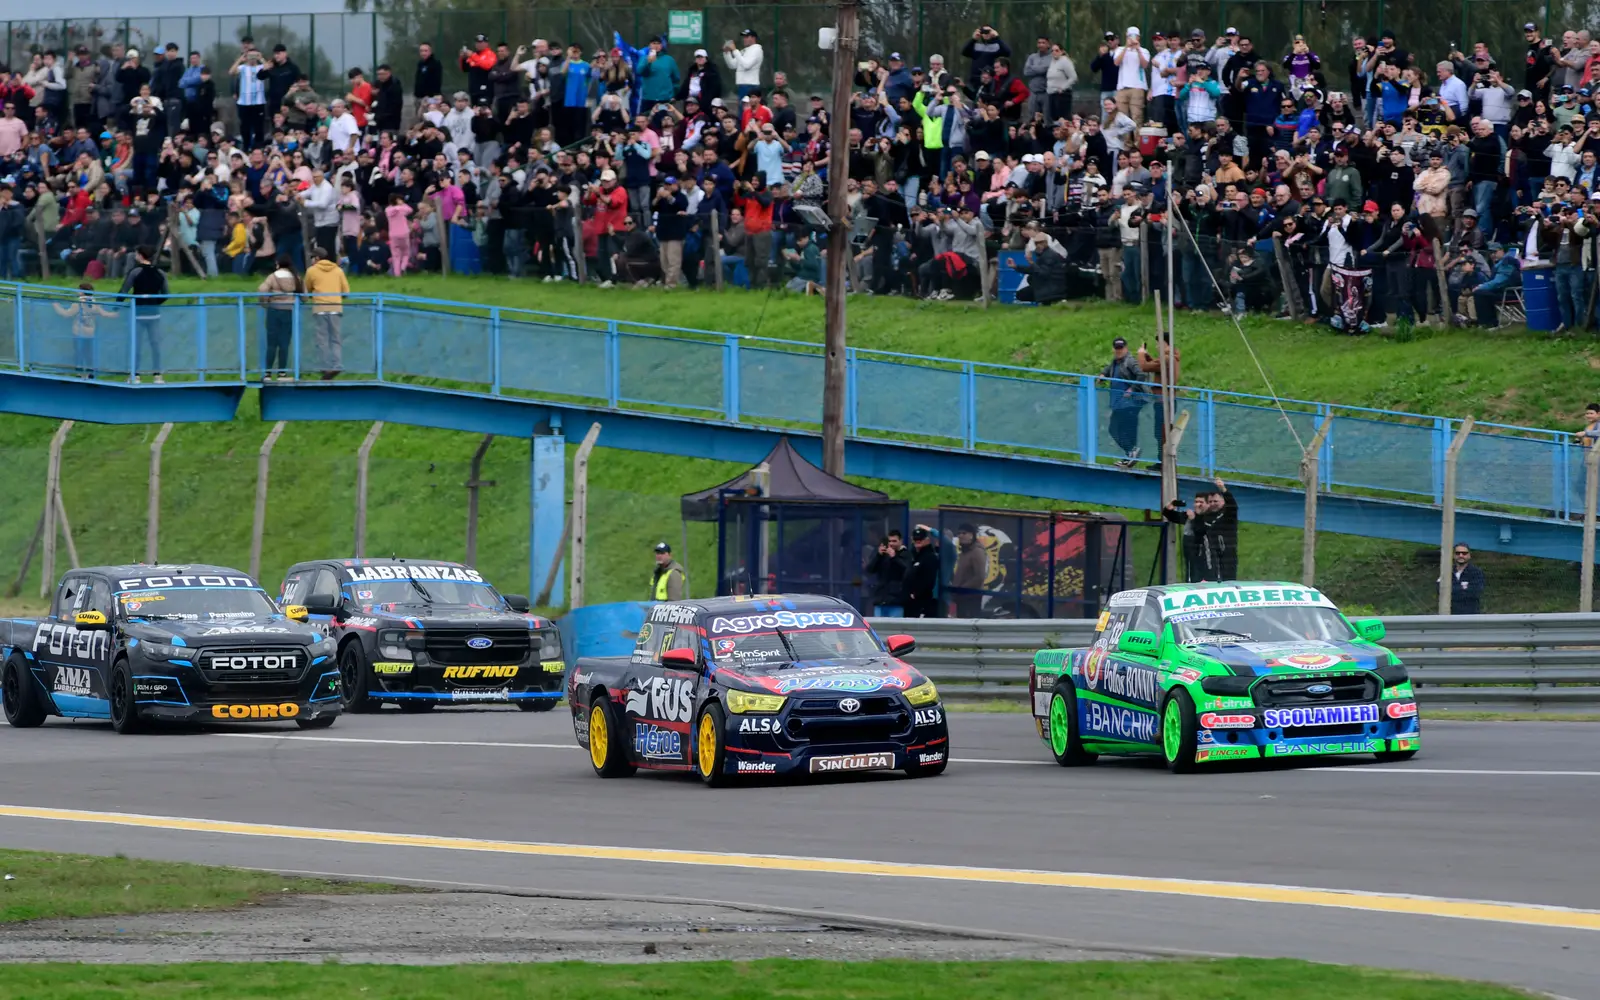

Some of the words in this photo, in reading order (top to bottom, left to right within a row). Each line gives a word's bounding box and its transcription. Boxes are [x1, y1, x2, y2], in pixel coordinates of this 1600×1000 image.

[346, 565, 483, 583] LABRANZAS
[119, 575, 253, 590] FOTON
[1164, 590, 1322, 611] LAMBERT
[78, 613, 100, 621] COIRO
[712, 611, 854, 633] AgroSpray
[32, 622, 109, 661] FOTON
[1127, 635, 1153, 645] IRIA
[211, 656, 297, 670] FOTON
[372, 662, 415, 674] TRENTO
[54, 666, 91, 688] AMA
[442, 665, 519, 679] RUFINO
[1103, 659, 1125, 696] Pollos
[1279, 672, 1355, 680] RANGER
[651, 676, 693, 723] RUS
[211, 703, 300, 718] COIRO
[915, 709, 936, 725] ALS
[1264, 704, 1379, 728] SCOLAMIERI
[739, 717, 771, 733] ALS
[1091, 703, 1155, 741] BANCHIK
[1201, 713, 1255, 728] CAIBO
[635, 723, 681, 757] Héroe
[1274, 741, 1378, 754] BANCHIK
[737, 761, 776, 771] Wander
[818, 756, 888, 772] SINCULPA
